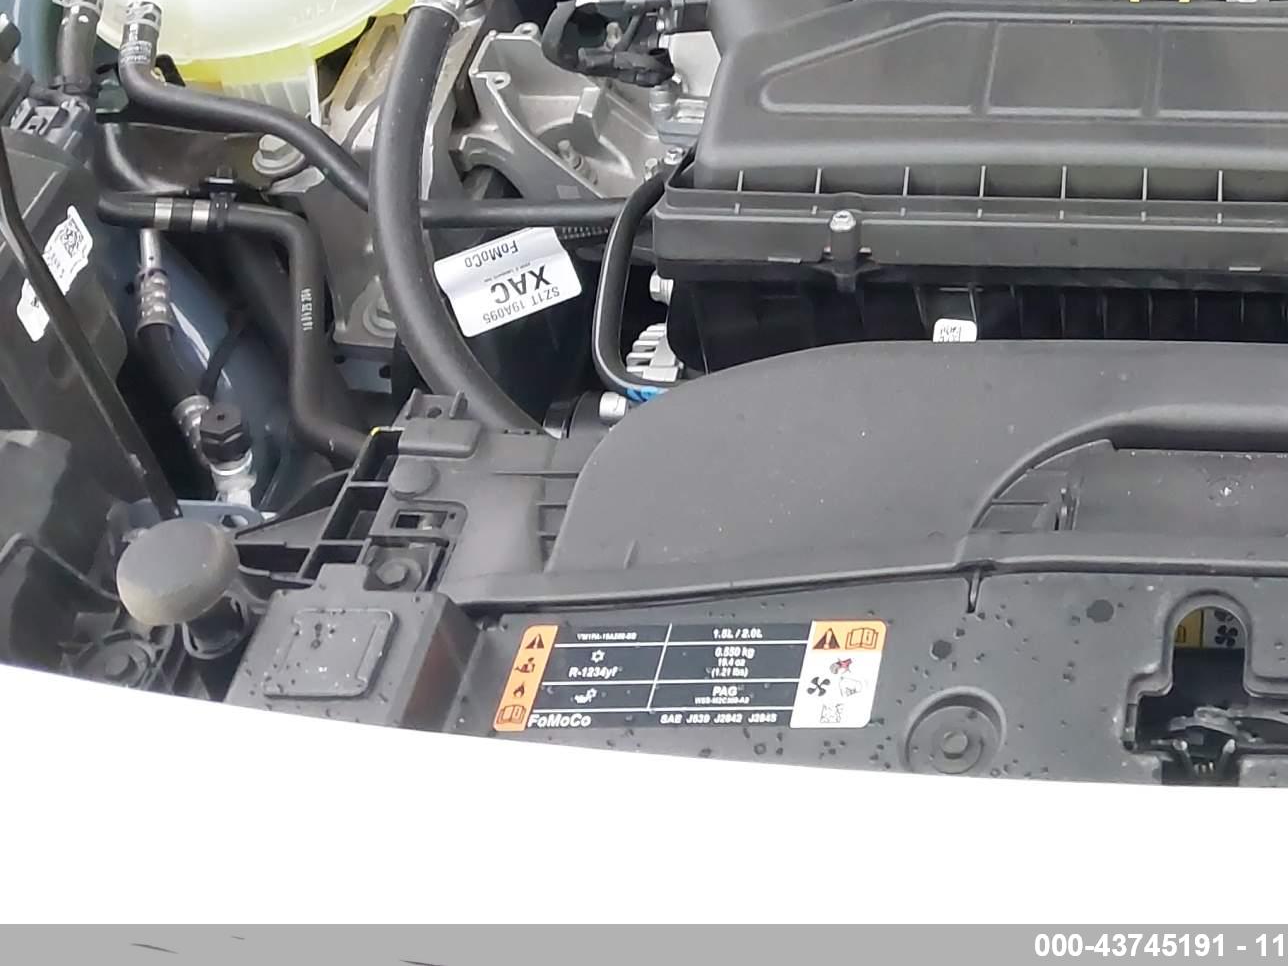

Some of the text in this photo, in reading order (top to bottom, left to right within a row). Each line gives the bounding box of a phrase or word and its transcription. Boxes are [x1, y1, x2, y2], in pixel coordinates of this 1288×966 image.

[464, 240, 519, 268] FoMoCo
[490, 264, 551, 304] XAC
[482, 286, 561, 324] SZ1T 19A095
[568, 666, 619, 679] R-1234yf
[712, 685, 738, 697] PAG
[527, 714, 592, 728] FoMoCo
